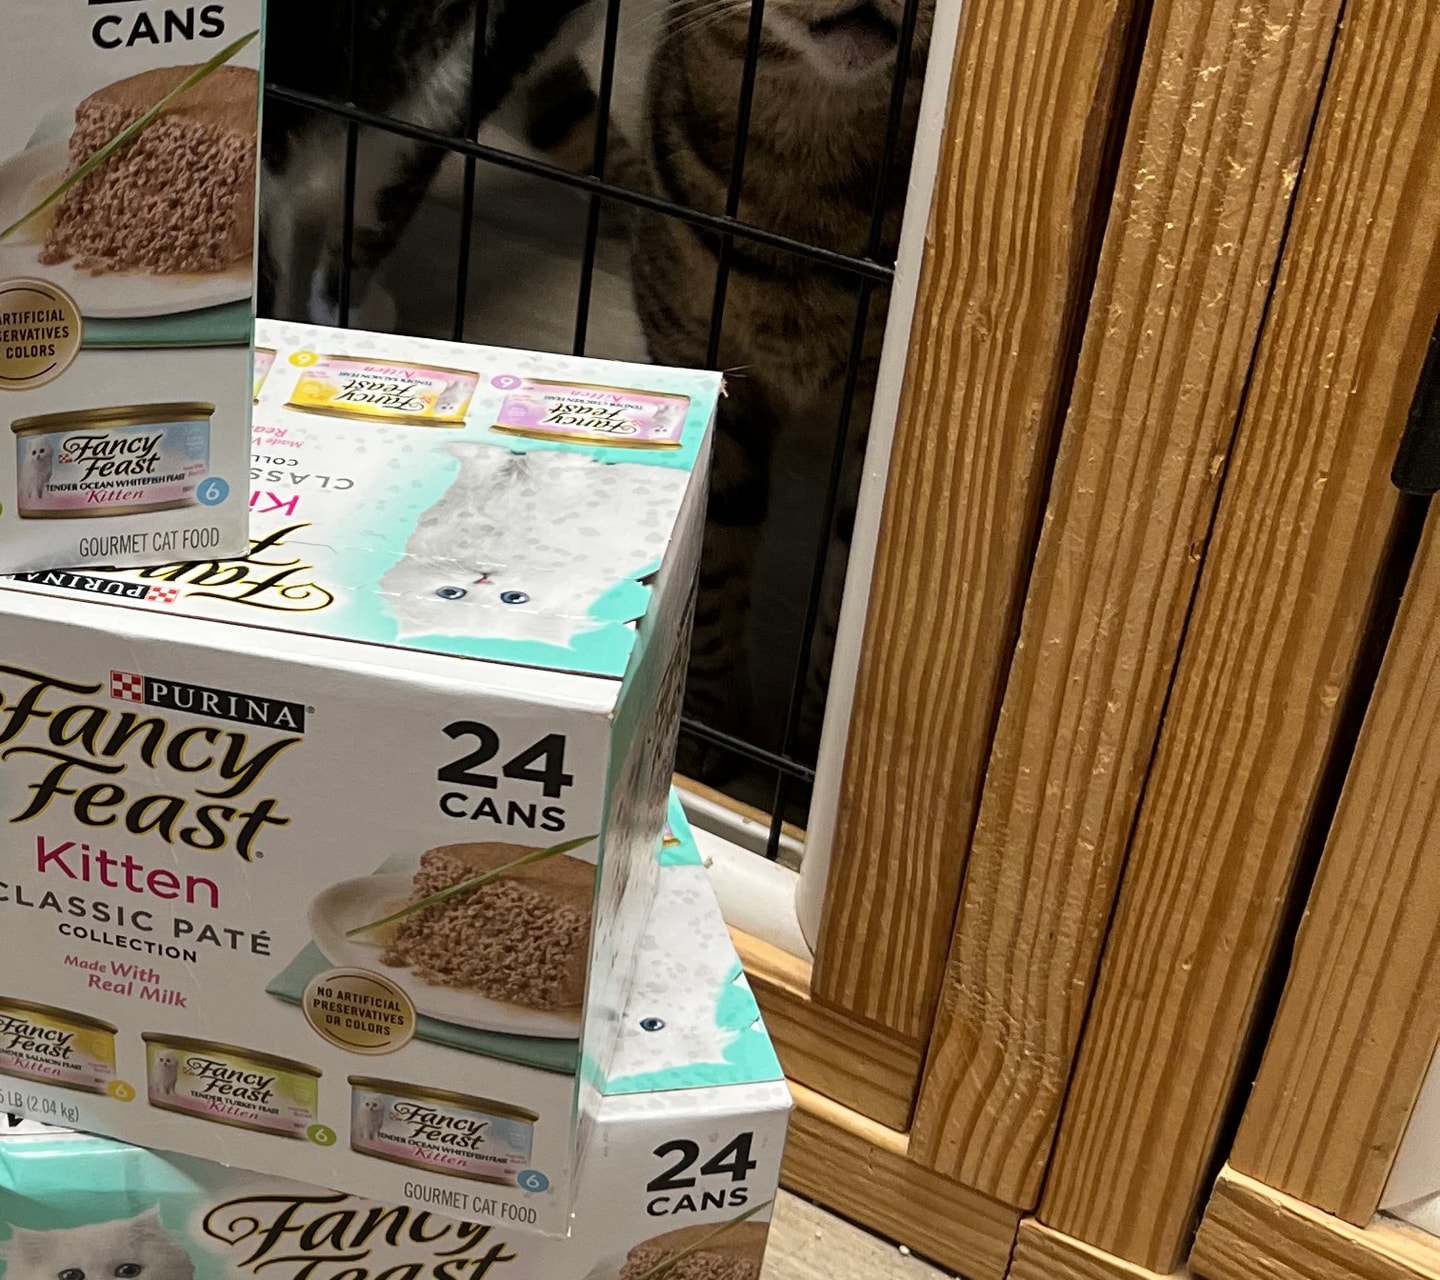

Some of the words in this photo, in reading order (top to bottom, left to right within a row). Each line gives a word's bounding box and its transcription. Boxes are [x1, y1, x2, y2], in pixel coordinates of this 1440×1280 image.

[92, 5, 225, 49] CANS
[6, 344, 55, 359] COLORS
[62, 432, 163, 462] Fancy
[46, 482, 78, 492] TENDER
[79, 480, 114, 491] OCEAN
[116, 476, 163, 488] WHITEFISH
[164, 473, 186, 483] FEAST
[80, 454, 161, 481] Feast
[85, 488, 145, 504] Kitten
[205, 483, 220, 499] 6
[79, 533, 148, 557] GOURMET
[152, 530, 179, 551] CAT
[182, 527, 219, 548] FOOD
[150, 682, 300, 729] PURINA
[437, 720, 573, 799] 24
[1, 746, 292, 863] Feast
[439, 791, 566, 832] CANS
[36, 836, 220, 909] Kitten
[58, 923, 198, 963] COLLECTION
[173, 917, 271, 956] PATÉ
[64, 954, 107, 973] Made
[110, 961, 161, 985] With
[87, 973, 134, 997] Real
[139, 985, 188, 1008] Milk
[317, 985, 333, 999] NO
[336, 989, 401, 1012] ARTIFICIAL
[312, 998, 405, 1026] PRESERVATIVES
[325, 1014, 342, 1026] OR
[345, 1016, 391, 1036] COLORS
[647, 1131, 757, 1192] 24
[403, 1180, 468, 1210] GOURMET
[472, 1195, 497, 1218] CAT
[500, 1201, 537, 1224] FOOD
[647, 1187, 748, 1216] CANS
